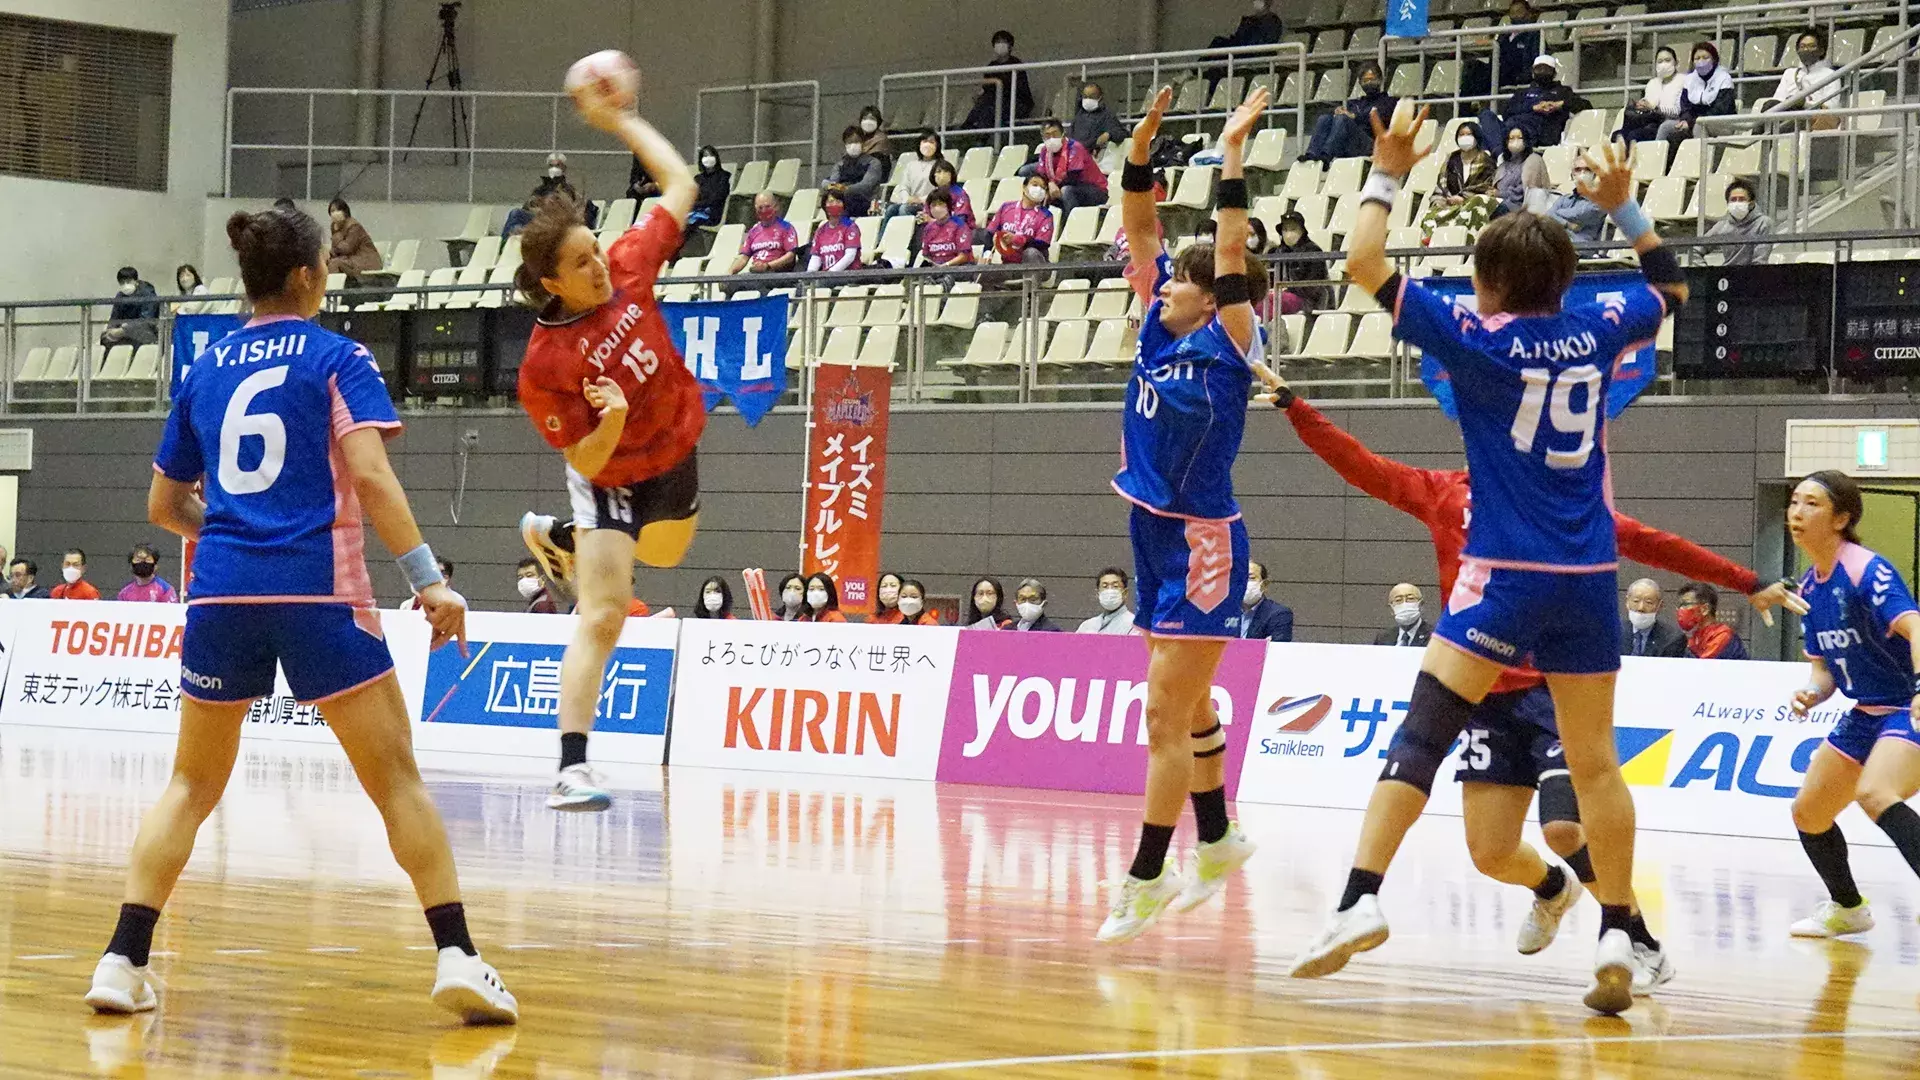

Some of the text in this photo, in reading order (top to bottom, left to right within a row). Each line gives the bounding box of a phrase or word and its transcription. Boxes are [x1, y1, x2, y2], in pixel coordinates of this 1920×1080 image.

[214, 335, 306, 367] Y.ISHII
[587, 303, 643, 373] youme
[1874, 347, 1920, 359] CITIZEN
[432, 373, 460, 384] CITIZEN
[622, 337, 659, 384] 15
[1136, 375, 1159, 419] 10
[1510, 364, 1602, 469] 19
[217, 365, 289, 495] 6
[848, 435, 875, 520] イズミ
[813, 433, 845, 582] メイプルレッ
[844, 582, 865, 592] you
[848, 590, 866, 600] me
[50, 621, 183, 660] TOSHIBA
[701, 640, 936, 673] よろこびがつなぐ世界へ
[484, 655, 647, 720] 広島行
[723, 686, 901, 757] KIRIN
[1692, 702, 1765, 723] ALways
[1260, 738, 1324, 757] Sanikleen
[1456, 729, 1491, 770] 25
